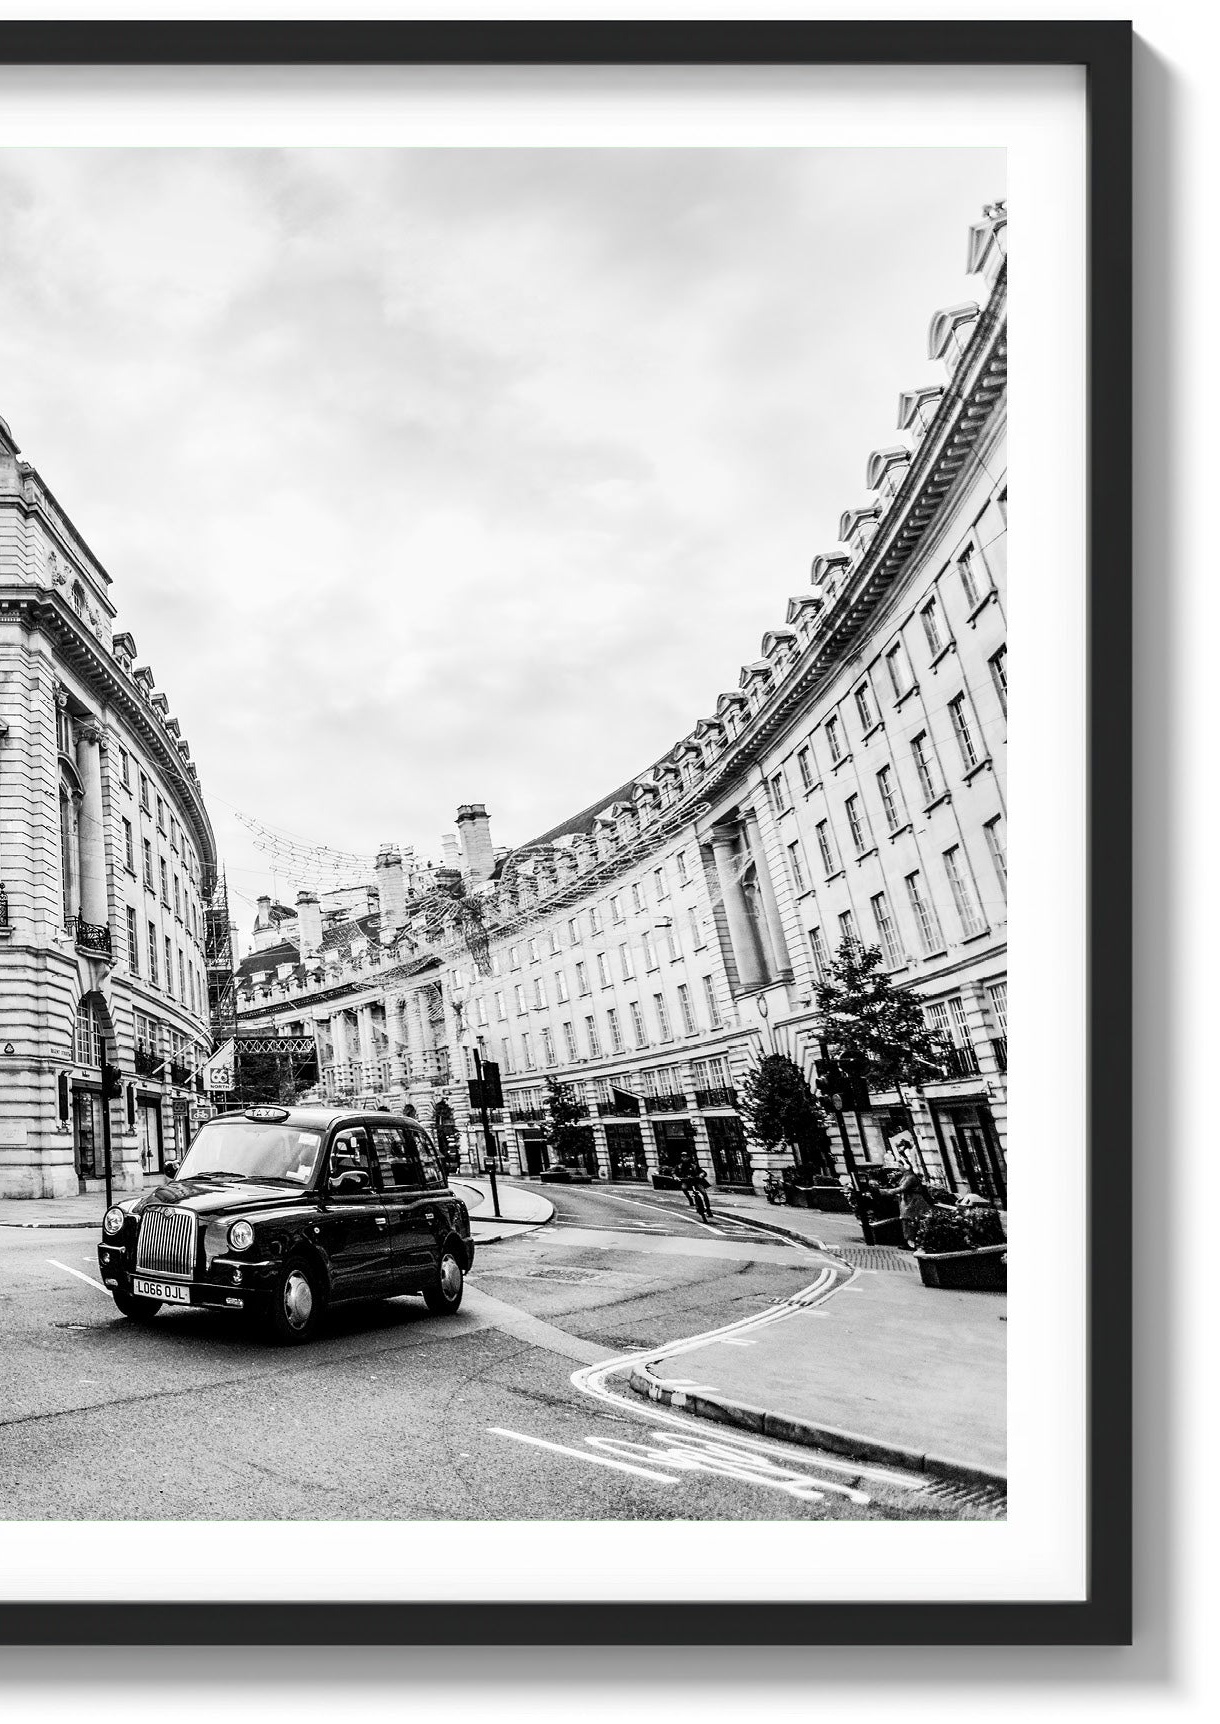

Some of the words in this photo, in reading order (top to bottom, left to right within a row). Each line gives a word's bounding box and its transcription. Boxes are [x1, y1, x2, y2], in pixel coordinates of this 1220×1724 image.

[210, 1069, 228, 1083] 66
[251, 1109, 276, 1117] TAXI
[164, 1285, 186, 1300] OJL
